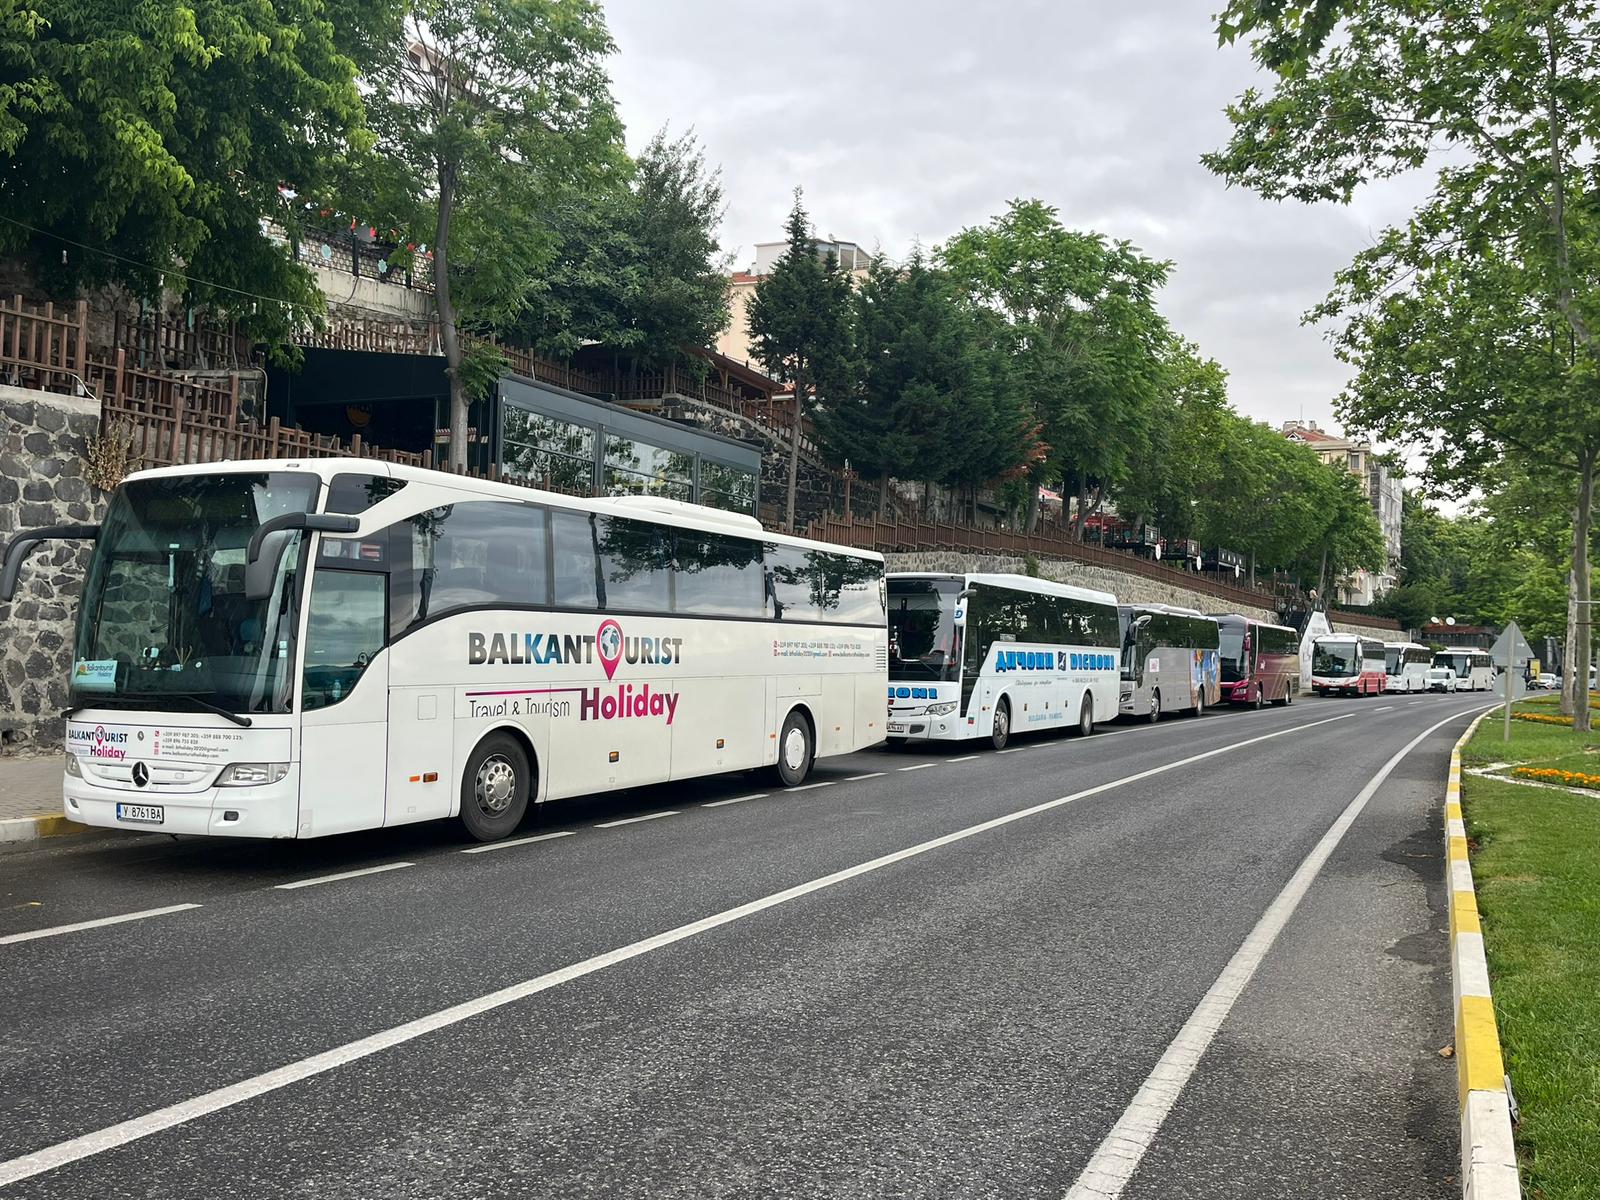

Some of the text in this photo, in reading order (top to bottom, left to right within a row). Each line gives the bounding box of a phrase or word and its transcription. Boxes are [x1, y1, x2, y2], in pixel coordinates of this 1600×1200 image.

[469, 697, 570, 718] Travel & Tourism
[580, 683, 679, 725] Holiday
[90, 745, 126, 762] Holiday
